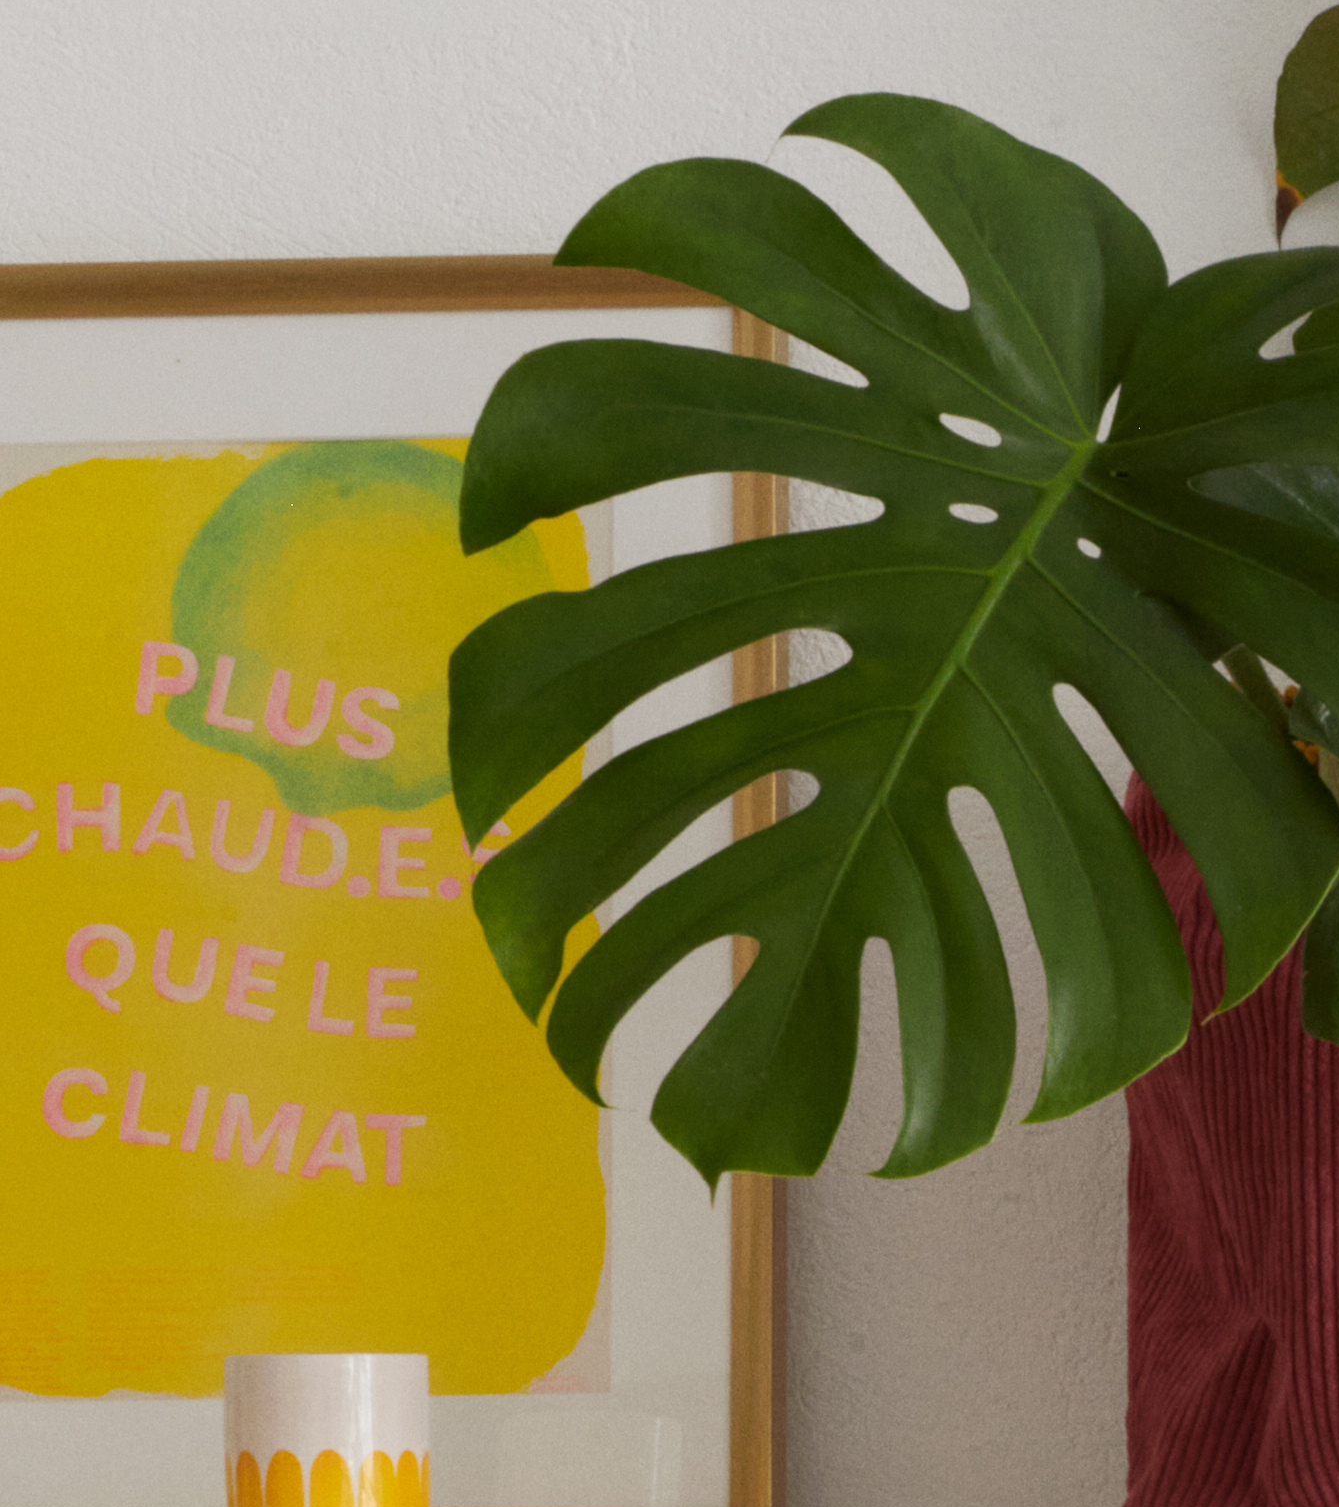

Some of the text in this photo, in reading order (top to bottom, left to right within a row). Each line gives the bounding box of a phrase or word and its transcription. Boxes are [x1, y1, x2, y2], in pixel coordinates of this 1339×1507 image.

[135, 640, 401, 759] PLUS
[65, 923, 419, 1038] QUE LE
[42, 1067, 427, 1186] CLIMAT
